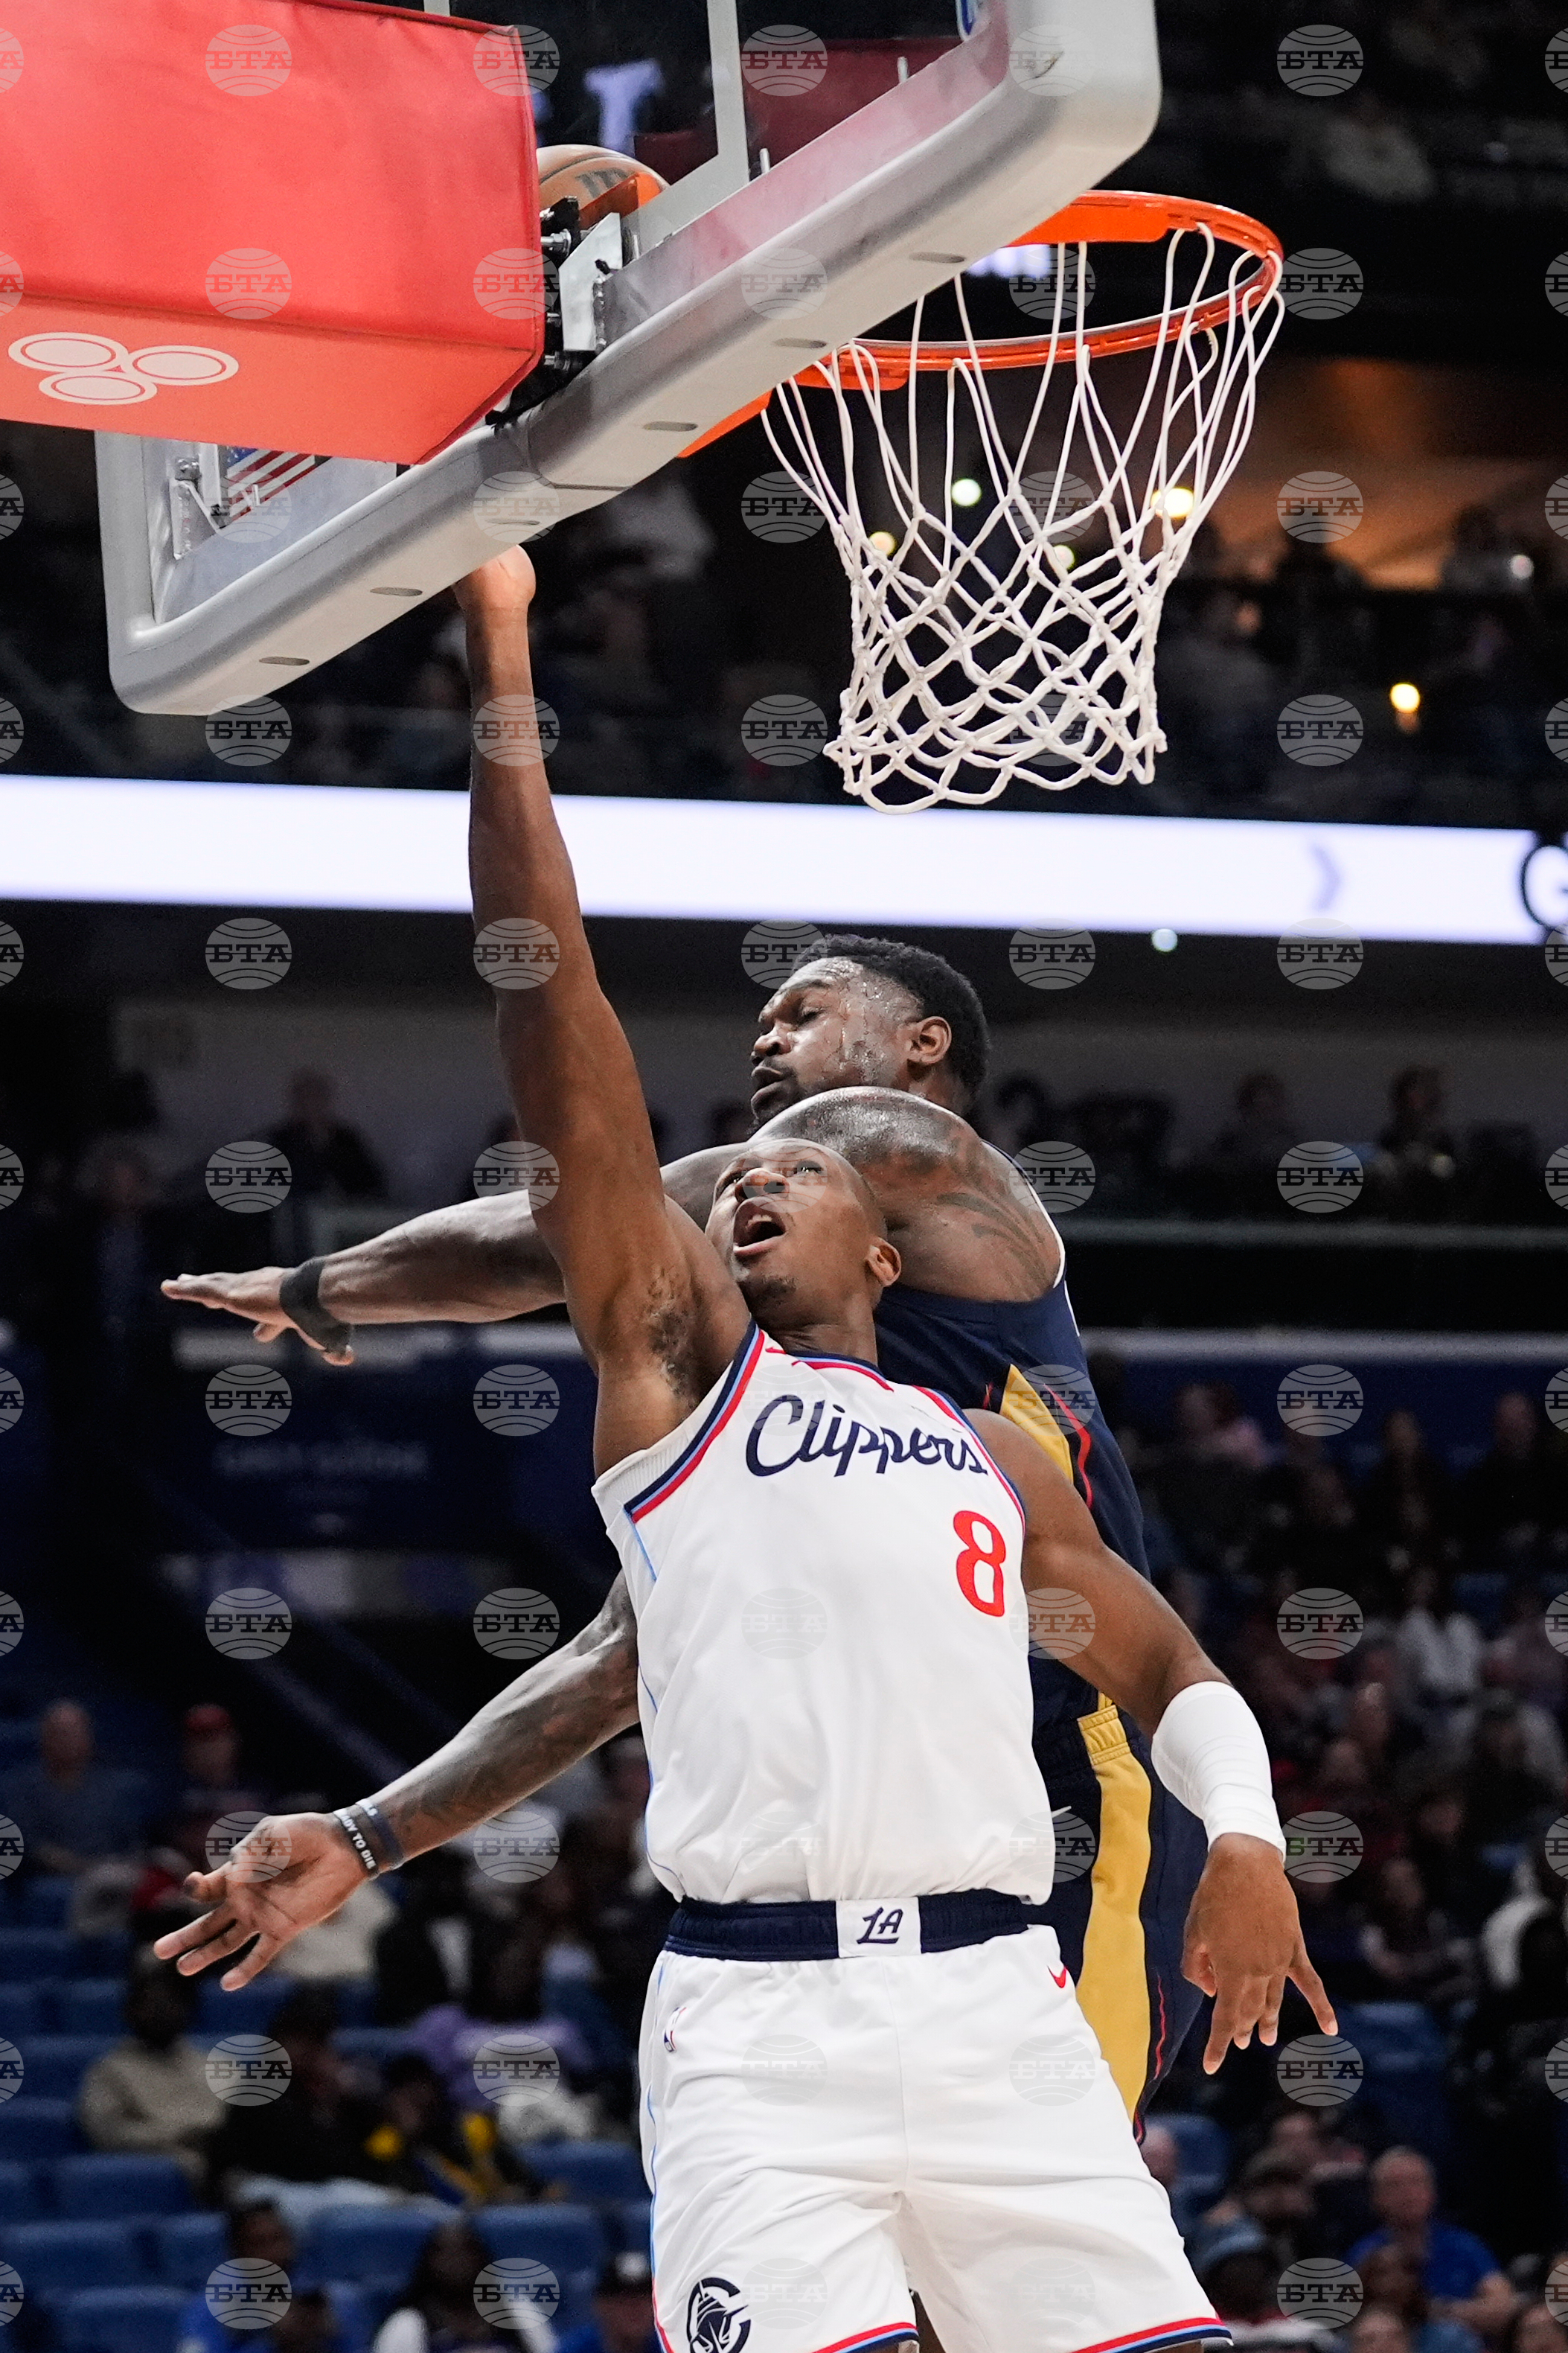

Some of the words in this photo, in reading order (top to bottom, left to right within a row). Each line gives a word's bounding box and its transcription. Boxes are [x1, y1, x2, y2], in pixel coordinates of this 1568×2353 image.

[746, 1394, 988, 1478] Clippers
[953, 1510, 1006, 1617] 8
[352, 1833, 367, 1849] TO
[856, 1906, 903, 1944] LA
